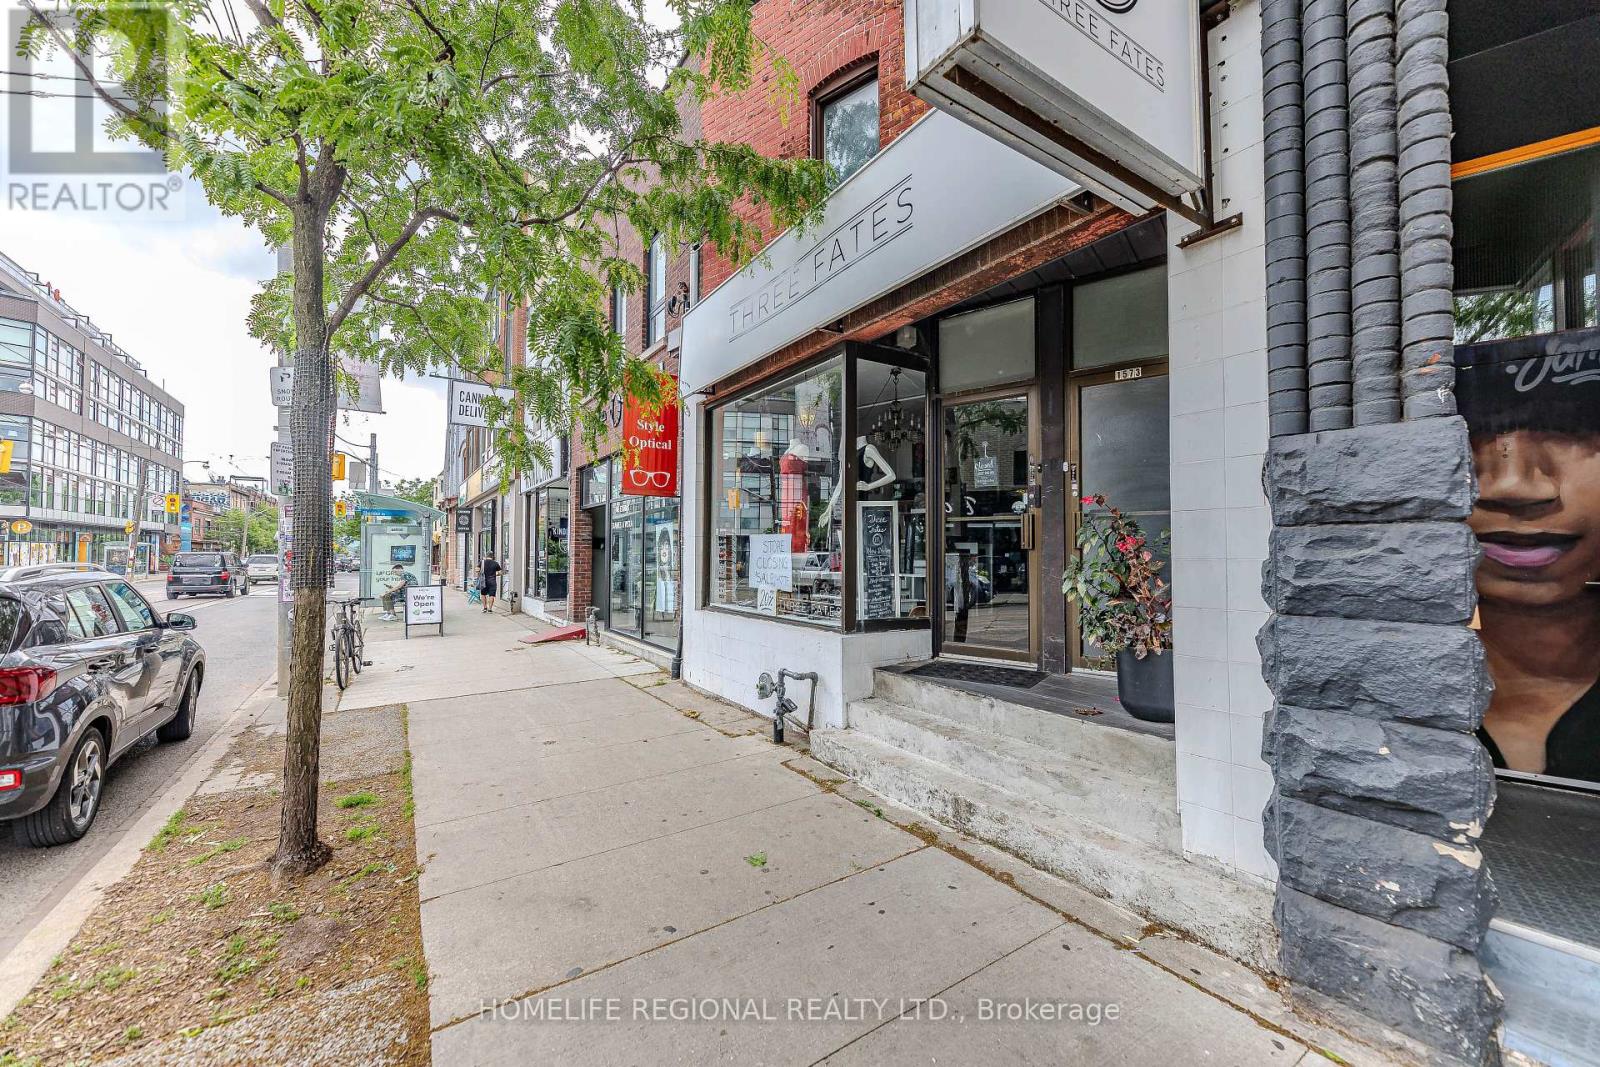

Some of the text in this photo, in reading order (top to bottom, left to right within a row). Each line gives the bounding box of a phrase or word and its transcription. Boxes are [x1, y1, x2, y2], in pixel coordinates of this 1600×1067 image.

[1110, 29, 1165, 88] FATES
[729, 187, 914, 334] THREE FATES
[1115, 367, 1142, 380] 1573
[459, 390, 504, 405] CANN
[637, 419, 665, 435] Style
[629, 435, 672, 450] Optical
[762, 540, 785, 553] STORE
[413, 601, 435, 609] Open
